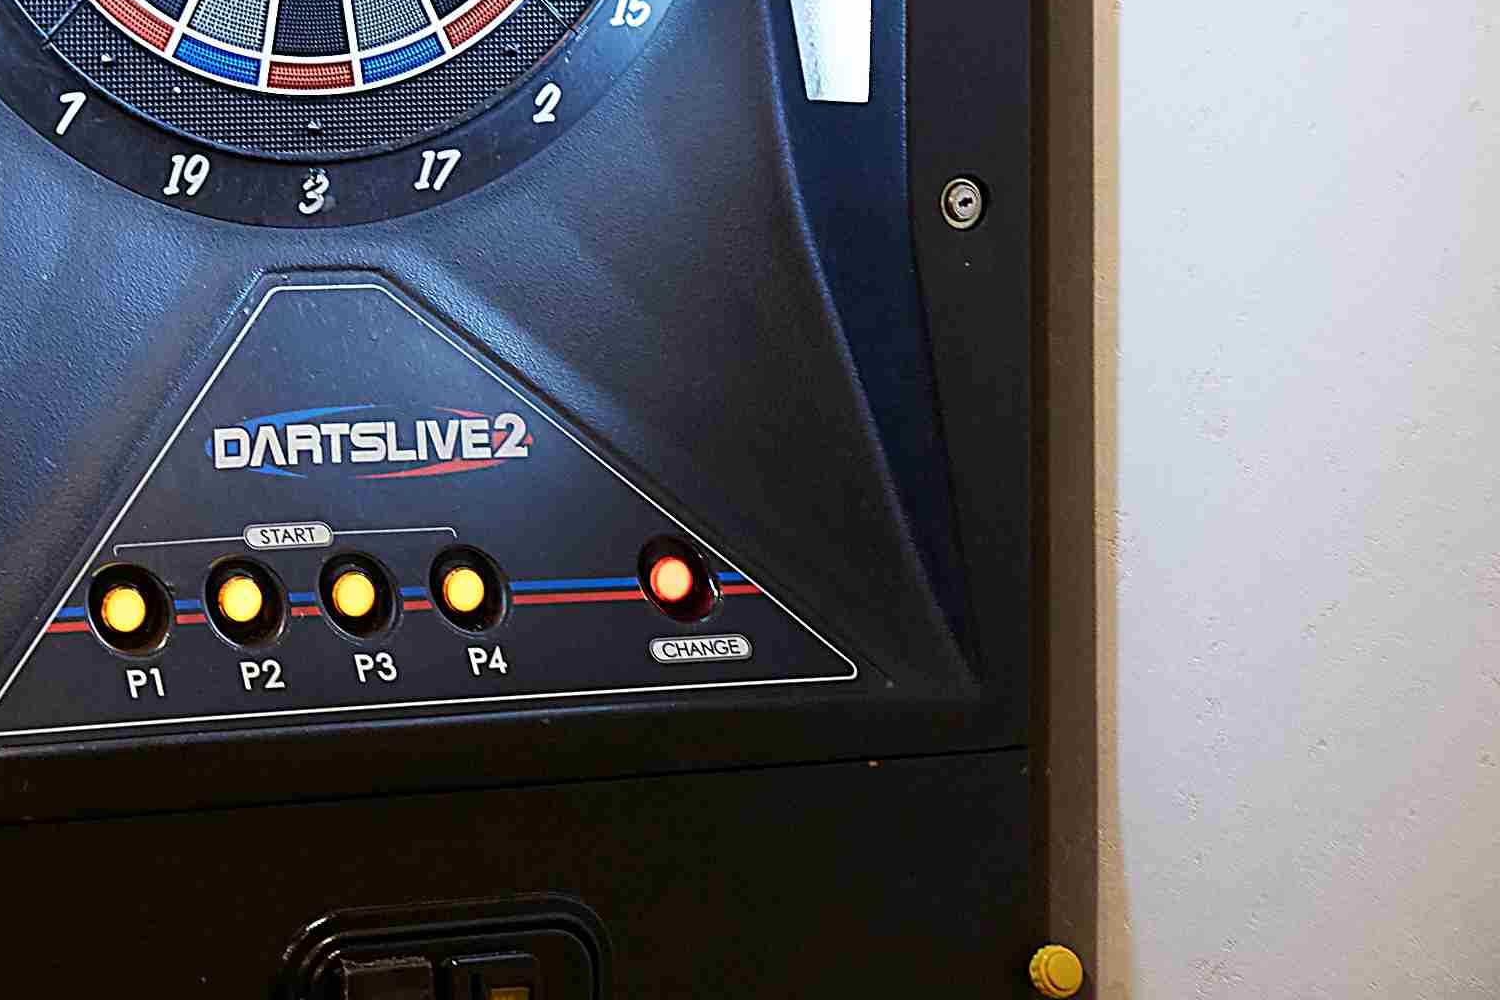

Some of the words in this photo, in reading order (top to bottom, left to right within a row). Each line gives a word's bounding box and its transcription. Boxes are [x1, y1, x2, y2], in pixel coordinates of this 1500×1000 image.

[54, 91, 87, 135] 7
[532, 82, 562, 123] 2
[162, 153, 210, 196] 19
[414, 149, 462, 191] 17
[298, 172, 331, 215] 3
[213, 412, 529, 470] DARTSLIVE2
[259, 526, 317, 545] START
[661, 639, 741, 659] CHANGE
[127, 668, 166, 698] P1
[240, 660, 286, 691] P2
[354, 652, 398, 683] P3
[468, 645, 508, 677] P4
